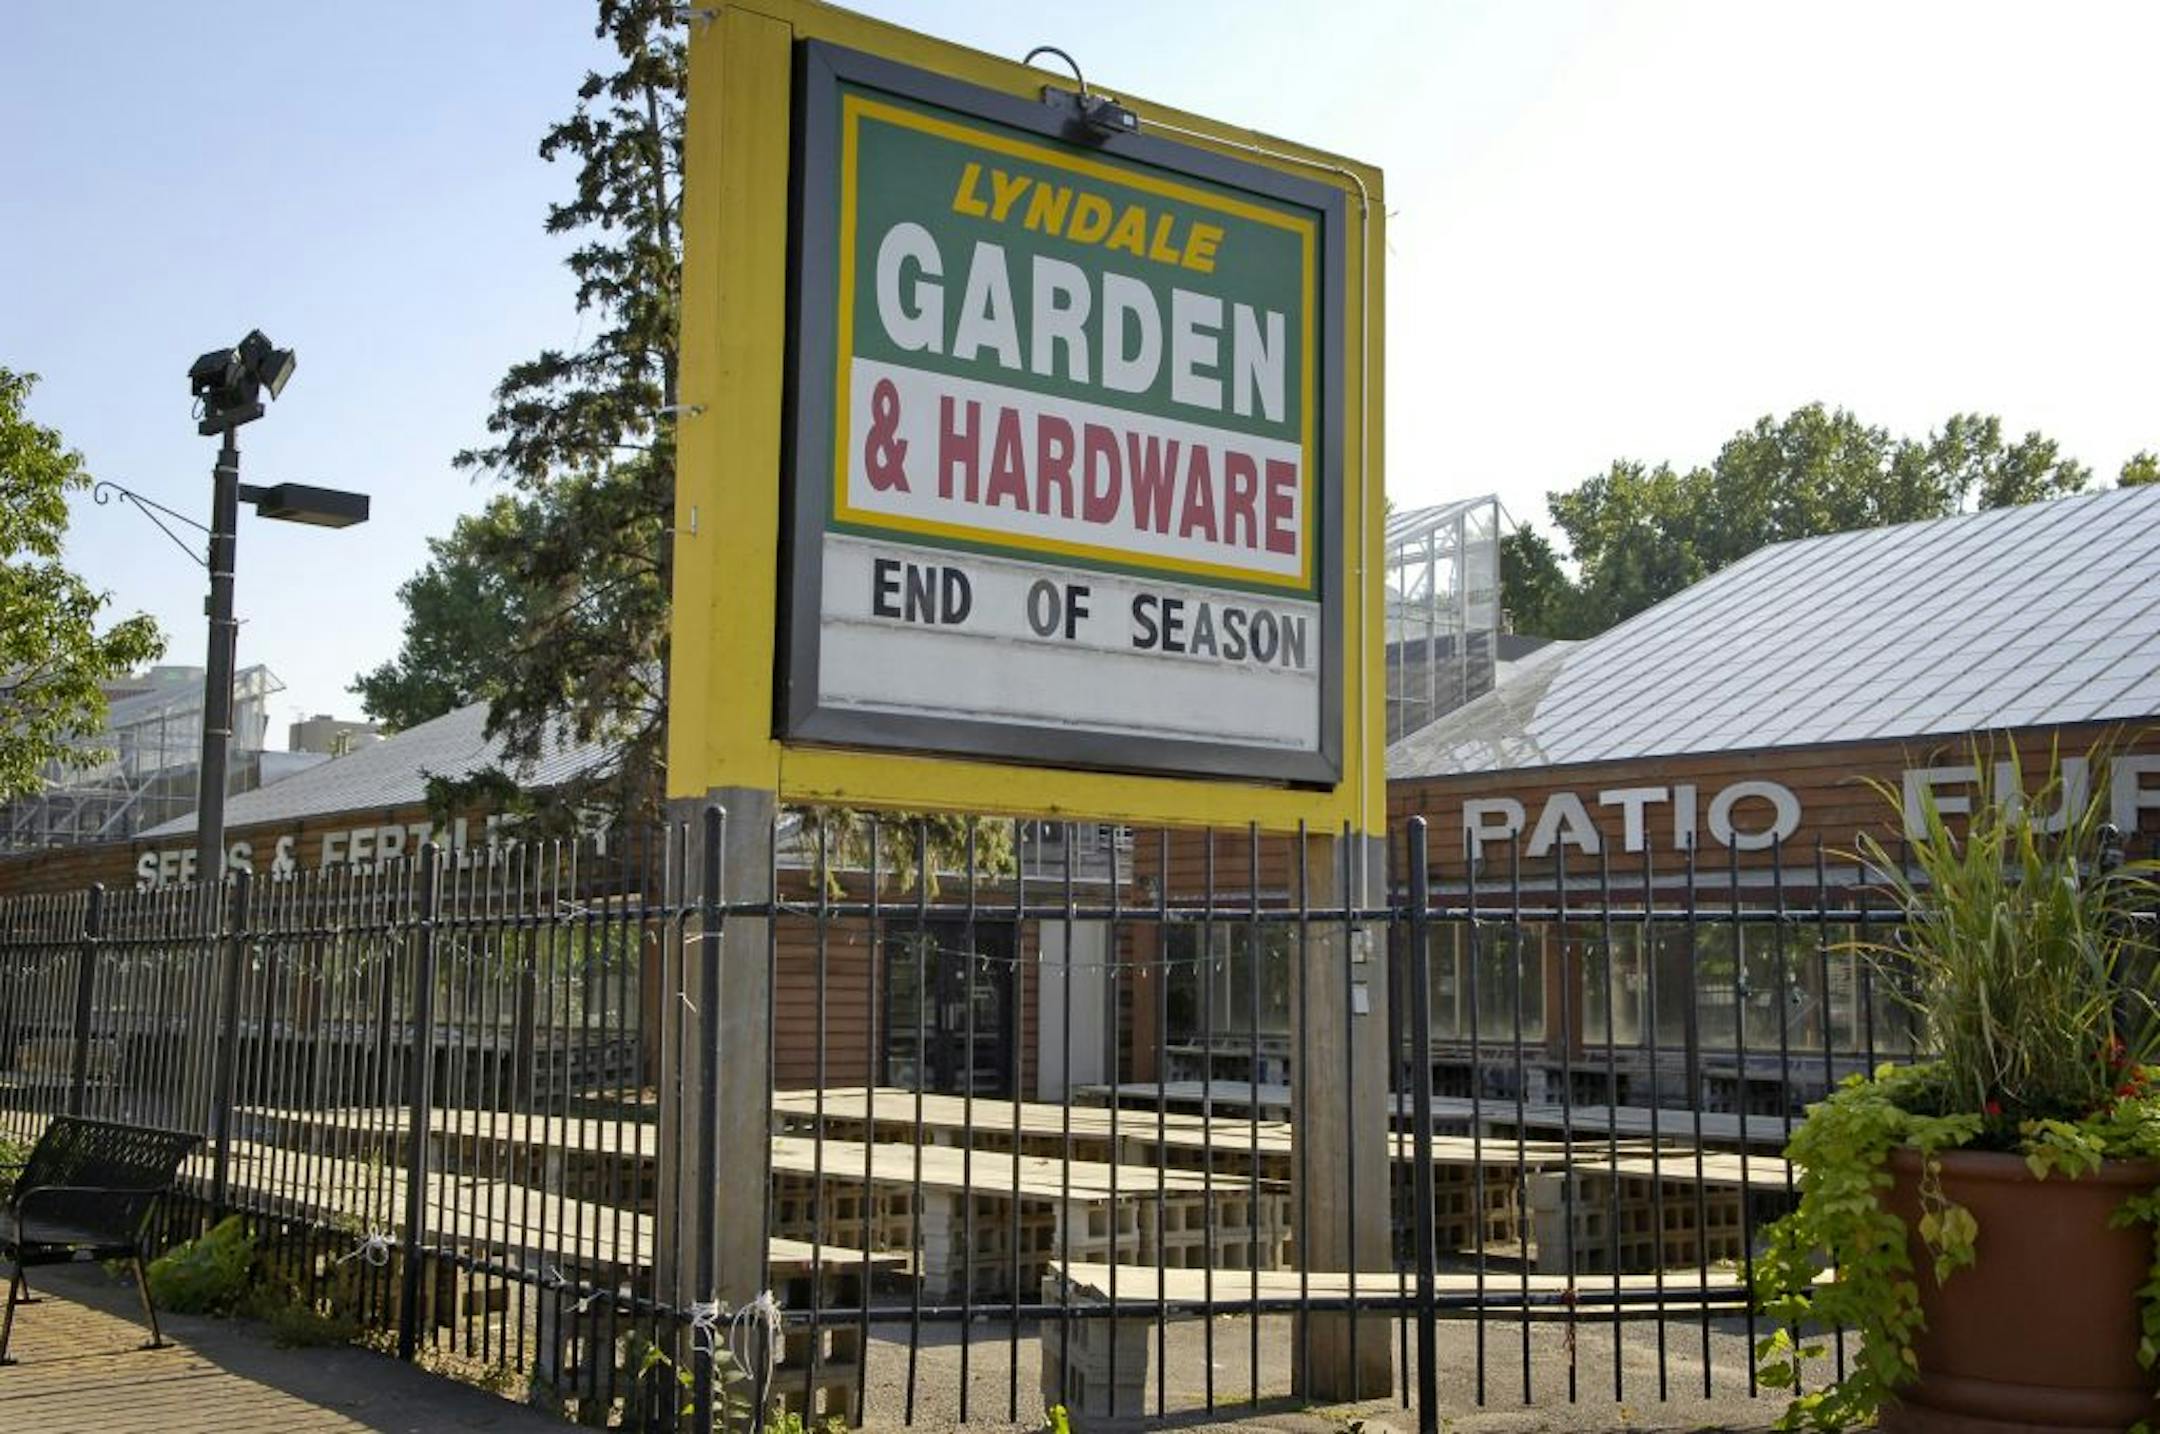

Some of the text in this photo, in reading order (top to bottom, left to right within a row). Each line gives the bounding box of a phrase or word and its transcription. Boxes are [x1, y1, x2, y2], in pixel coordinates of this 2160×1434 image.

[953, 162, 1224, 273] LYNDALE
[876, 222, 1286, 423] GARDEN
[865, 378, 1297, 556] & HARDWARE
[872, 557, 1307, 669] END OF SEASON
[135, 841, 253, 895] SEES
[271, 835, 296, 882] &
[1463, 780, 1802, 860] PATIO
